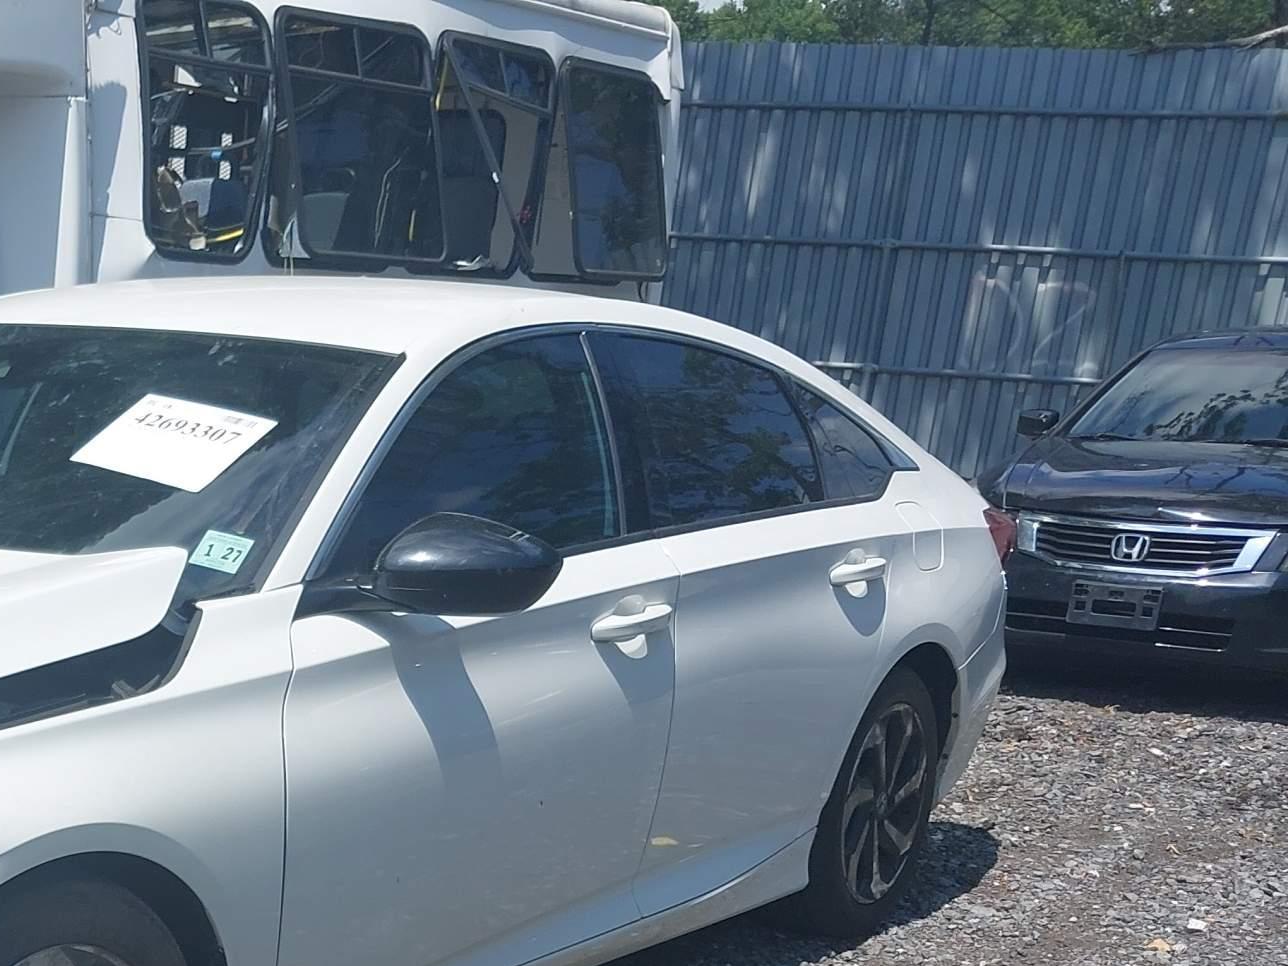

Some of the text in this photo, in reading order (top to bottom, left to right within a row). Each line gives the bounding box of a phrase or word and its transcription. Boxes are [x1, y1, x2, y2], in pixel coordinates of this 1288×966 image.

[134, 412, 243, 444] 42693307
[204, 543, 242, 563] 1 27
